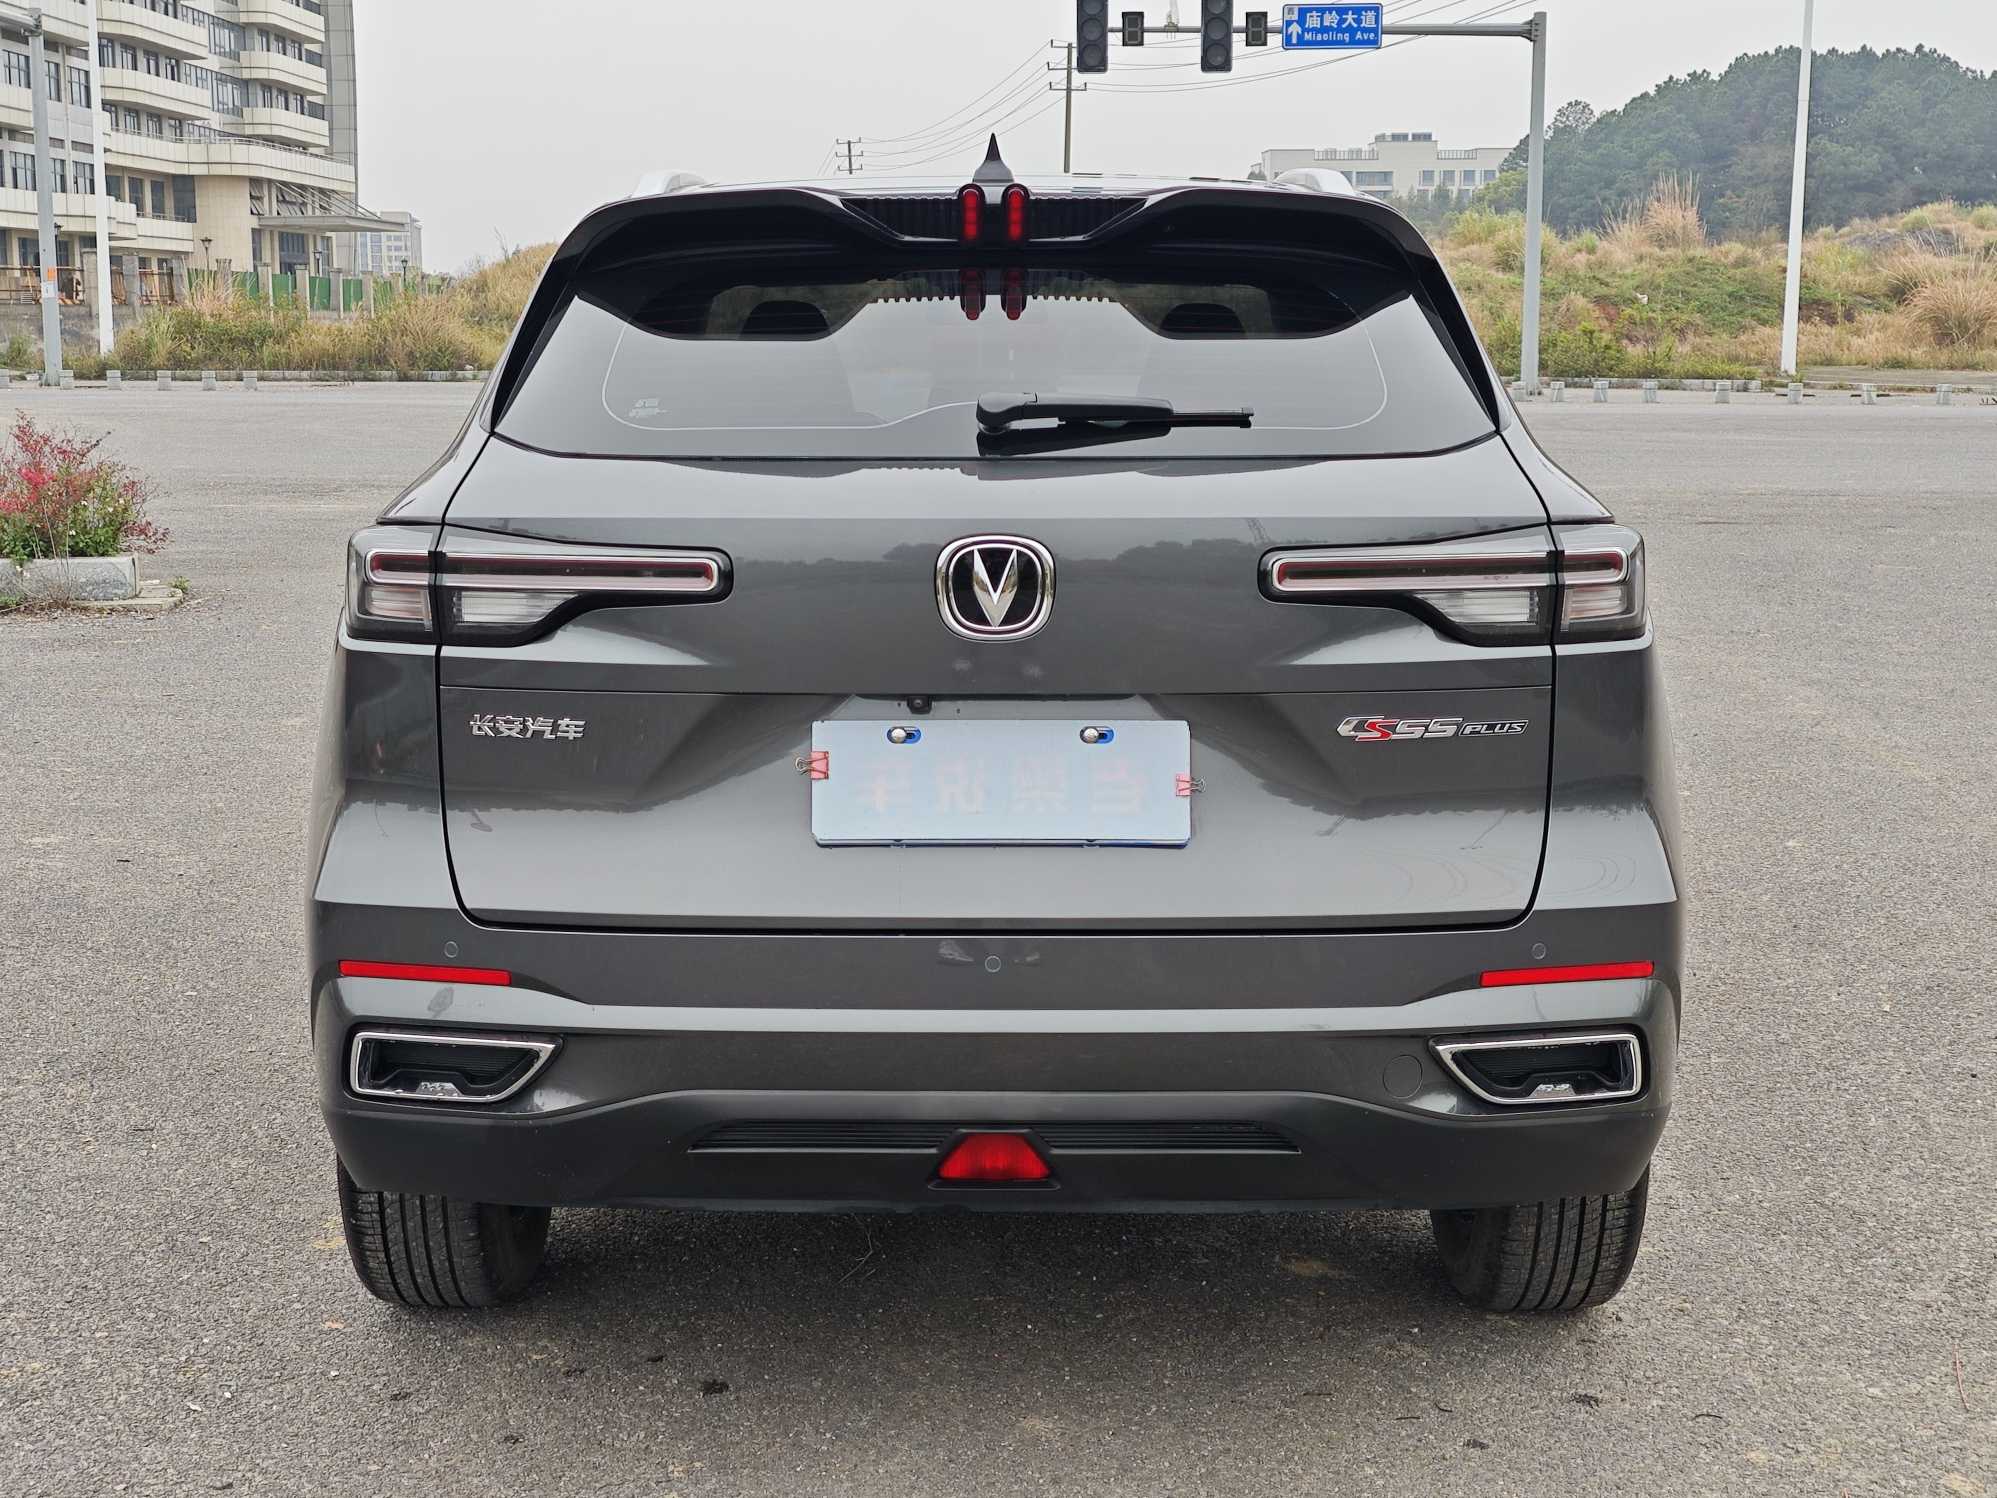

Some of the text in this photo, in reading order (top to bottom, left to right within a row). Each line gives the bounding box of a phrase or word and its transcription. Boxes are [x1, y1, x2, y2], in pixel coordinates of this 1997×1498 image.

[1305, 10, 1377, 28] 庙岭大道
[1304, 31, 1377, 43] Miaoling Ave.
[469, 713, 586, 740] 长安汽车
[1336, 716, 1527, 742] CS55 PLUS
